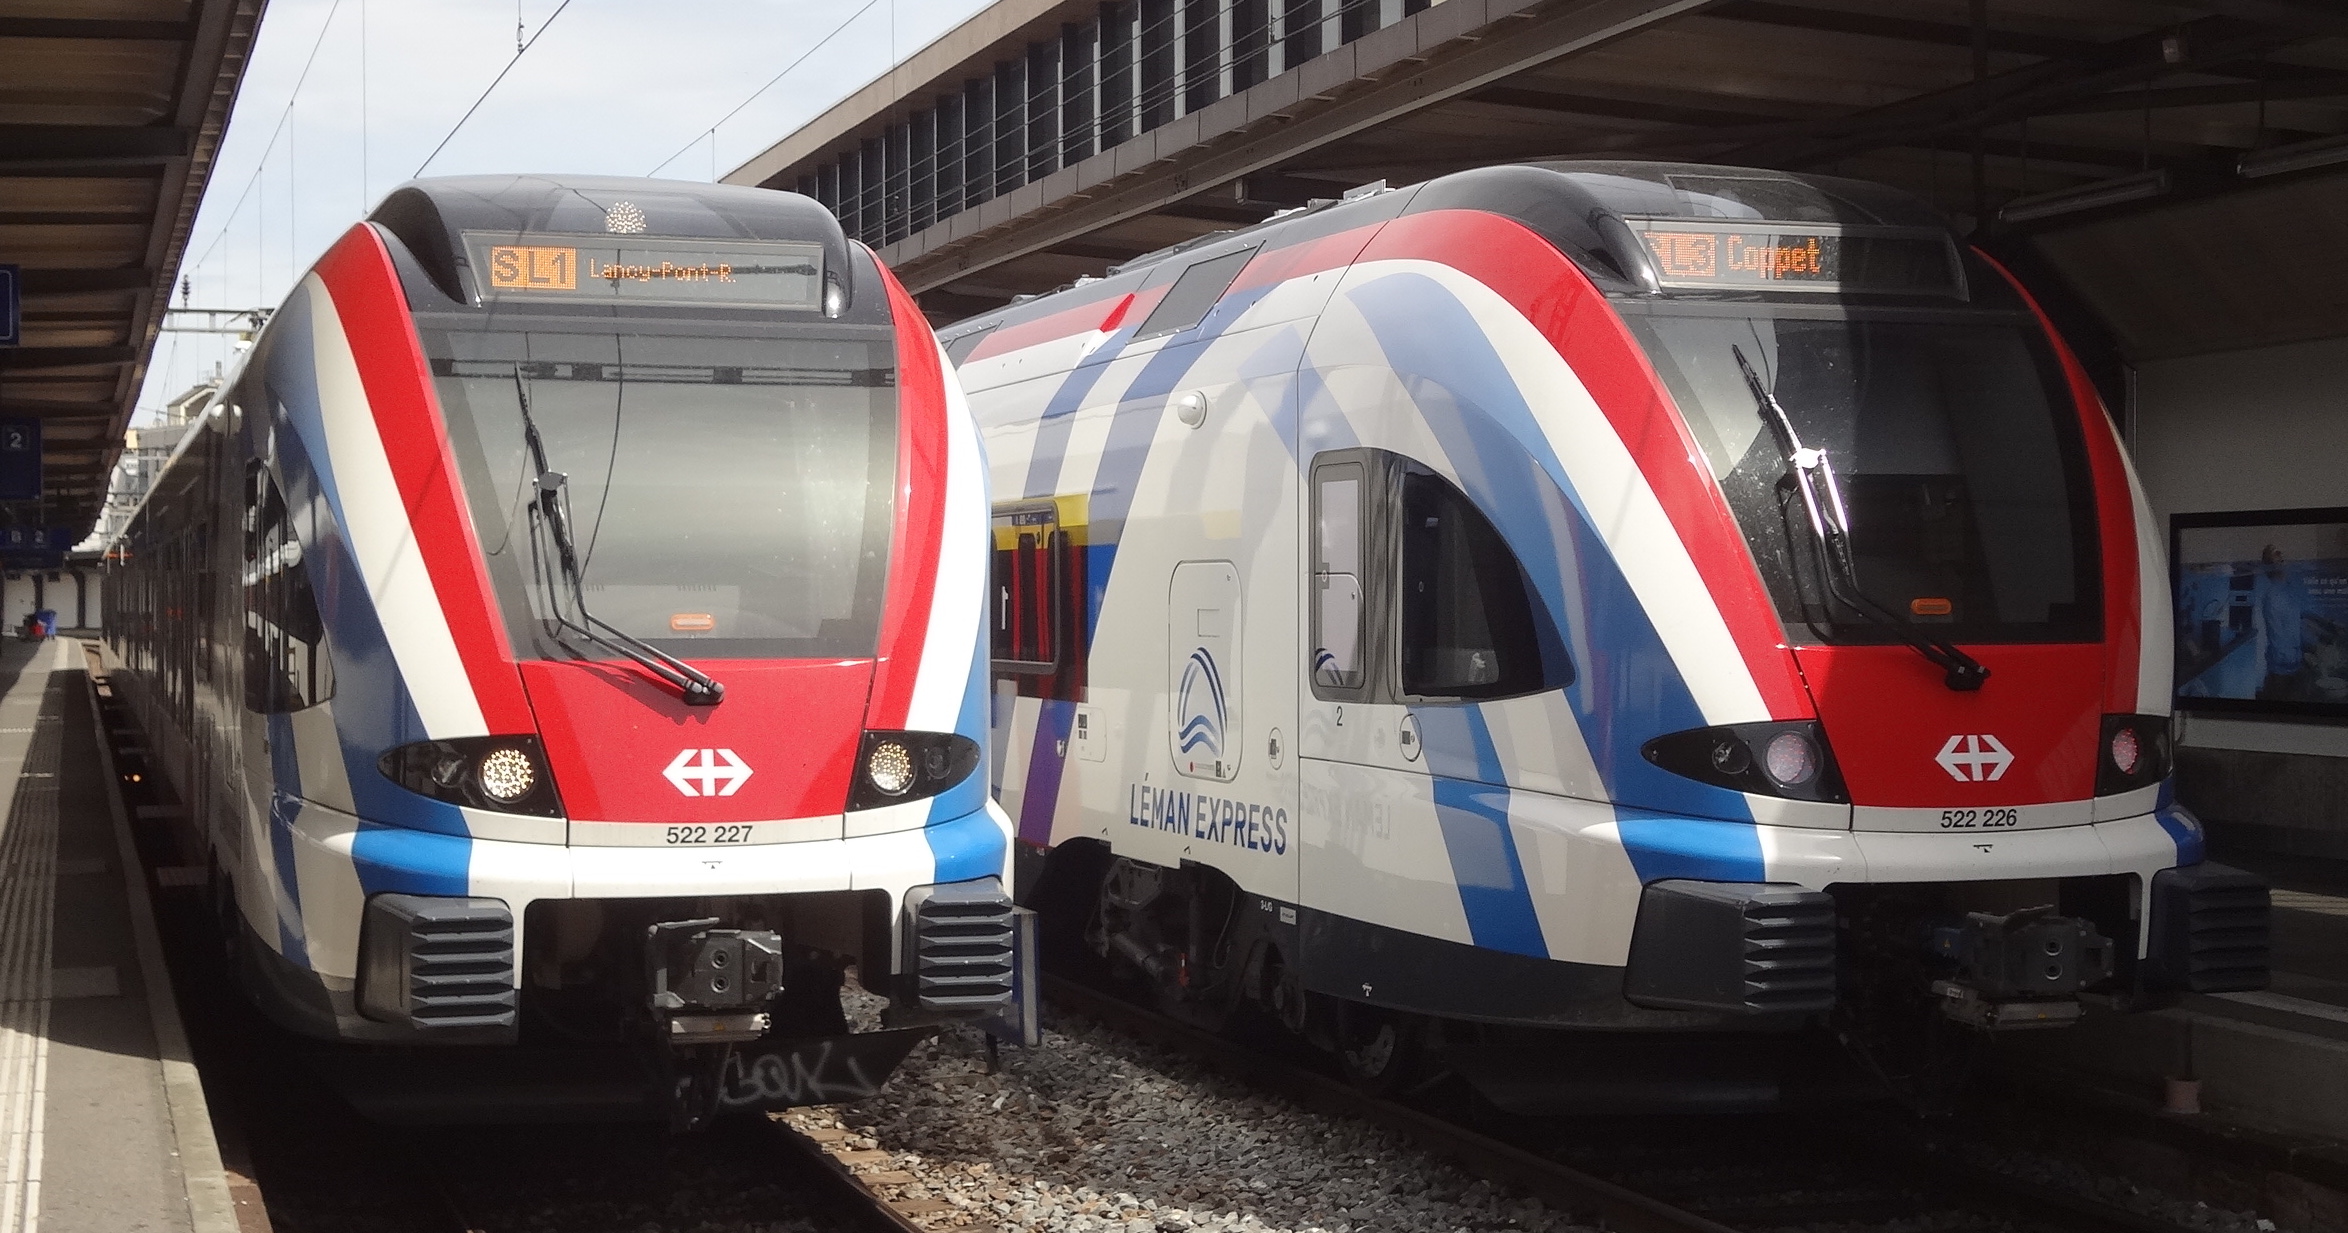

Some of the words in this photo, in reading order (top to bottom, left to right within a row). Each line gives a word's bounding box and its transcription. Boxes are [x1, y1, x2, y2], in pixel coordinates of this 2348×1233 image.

[1726, 234, 1821, 280] Coppet
[590, 257, 737, 283] Lancy-Pont-R.
[9, 431, 23, 450] 2
[1336, 705, 1343, 727] 2
[1129, 772, 1191, 836] LÉMAN
[1195, 795, 1288, 856] EXPRESS
[1940, 810, 1977, 828] 522
[1982, 809, 2018, 827] 226
[666, 827, 707, 844] 522
[713, 825, 753, 843] 227
